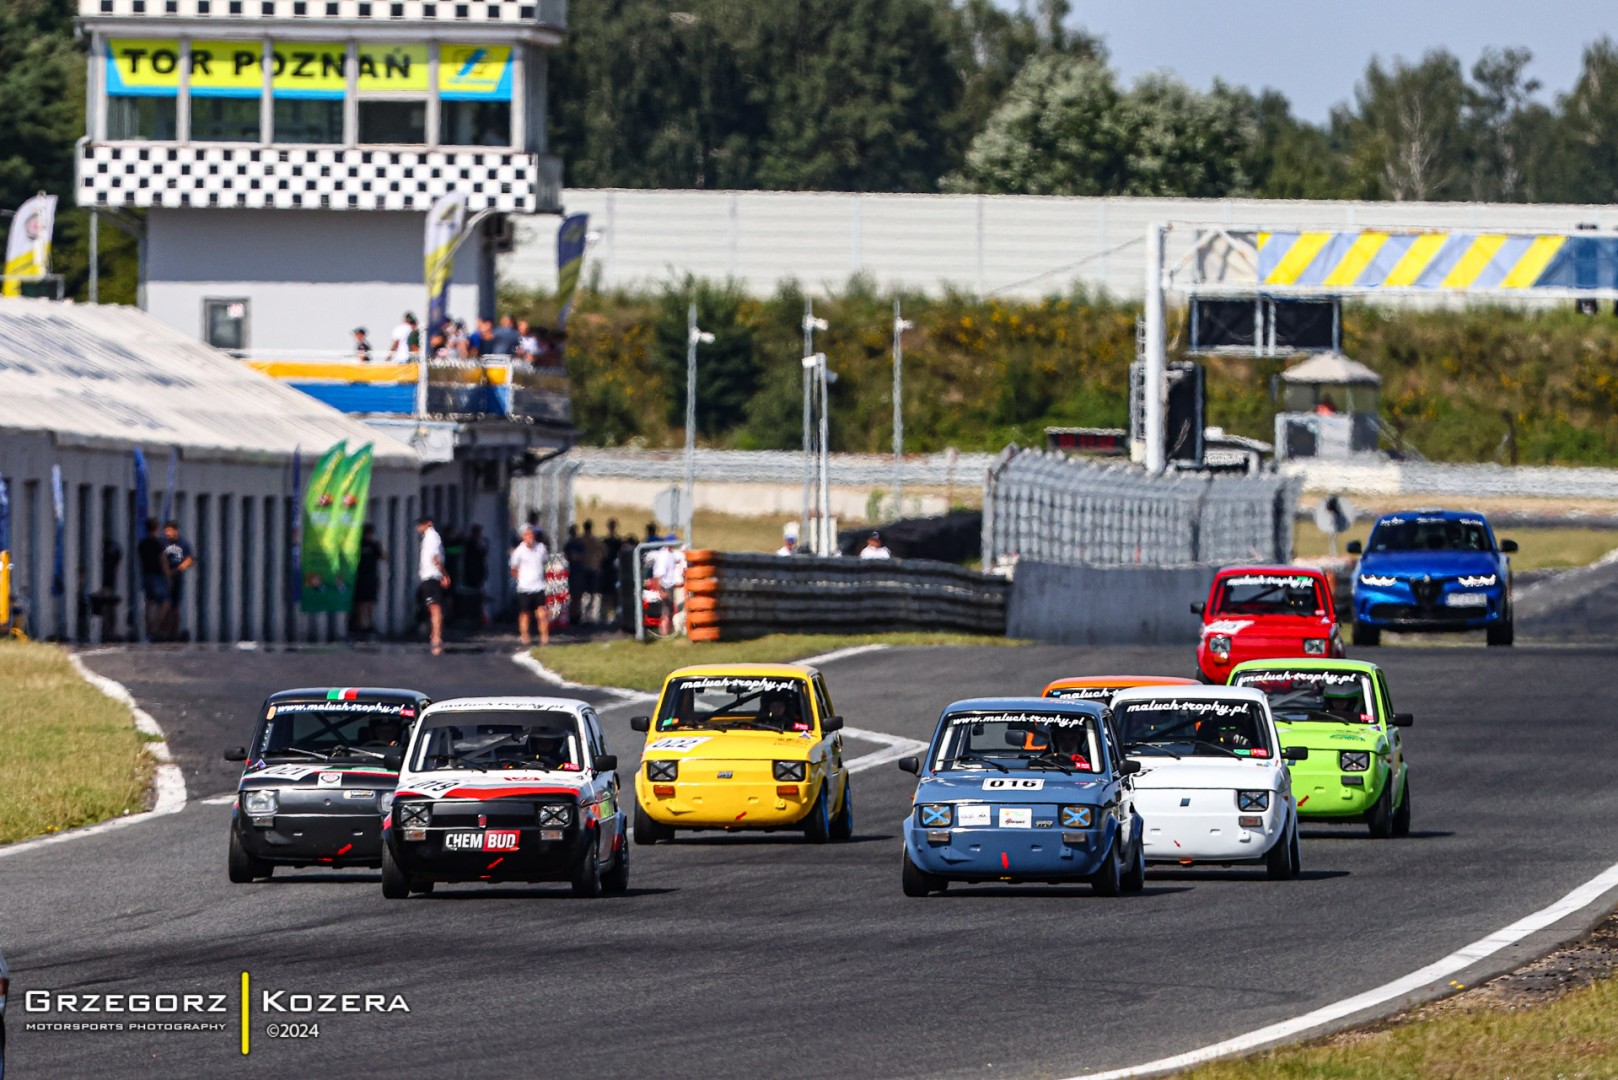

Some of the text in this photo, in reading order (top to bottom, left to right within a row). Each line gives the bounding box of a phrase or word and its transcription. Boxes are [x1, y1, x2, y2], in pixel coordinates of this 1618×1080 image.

[121, 47, 411, 78] TOR POZNAŃ
[680, 677, 795, 691] maluch-trophy.pl
[1241, 671, 1357, 685] maluch-trophy.pl
[1059, 687, 1120, 700] maluch-t
[277, 701, 405, 714] www.maluch-trophy.pl
[1127, 699, 1249, 716] maluch-trophy.pl
[953, 712, 1086, 728] www.maluch-trophy.pl
[652, 738, 699, 749] 022
[408, 779, 460, 792] 019
[989, 780, 1037, 788] 016
[445, 833, 517, 849] CHEM BUD
